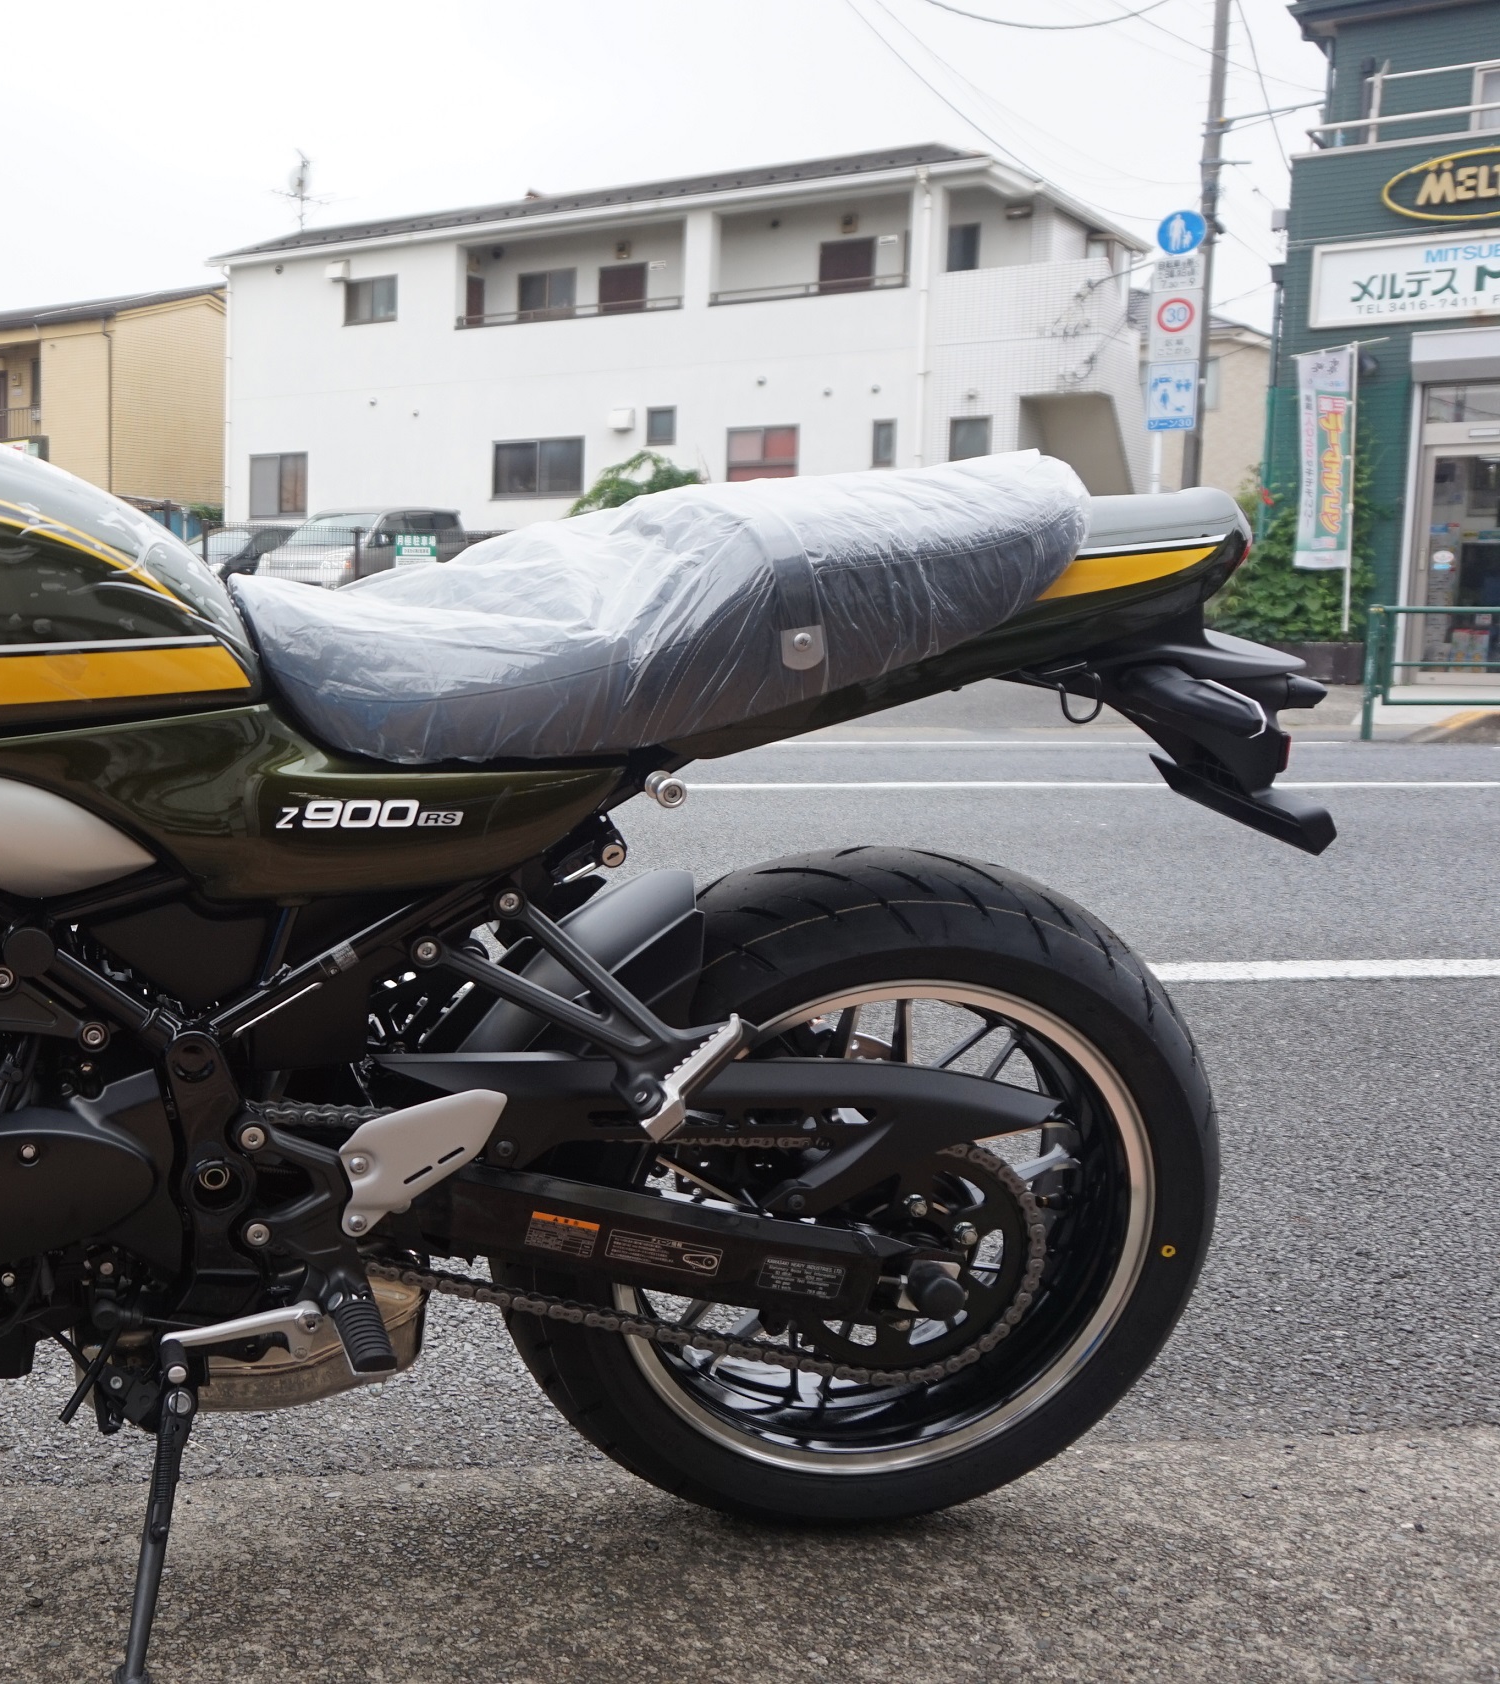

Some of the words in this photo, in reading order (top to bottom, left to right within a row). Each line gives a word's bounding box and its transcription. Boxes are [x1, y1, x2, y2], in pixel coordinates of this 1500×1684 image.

[1350, 267, 1459, 302] メルテス
[1167, 306, 1188, 323] 30
[1357, 304, 1384, 315] TEL
[1388, 296, 1478, 313] 3416-7411
[1149, 418, 1193, 429] ゾーン30
